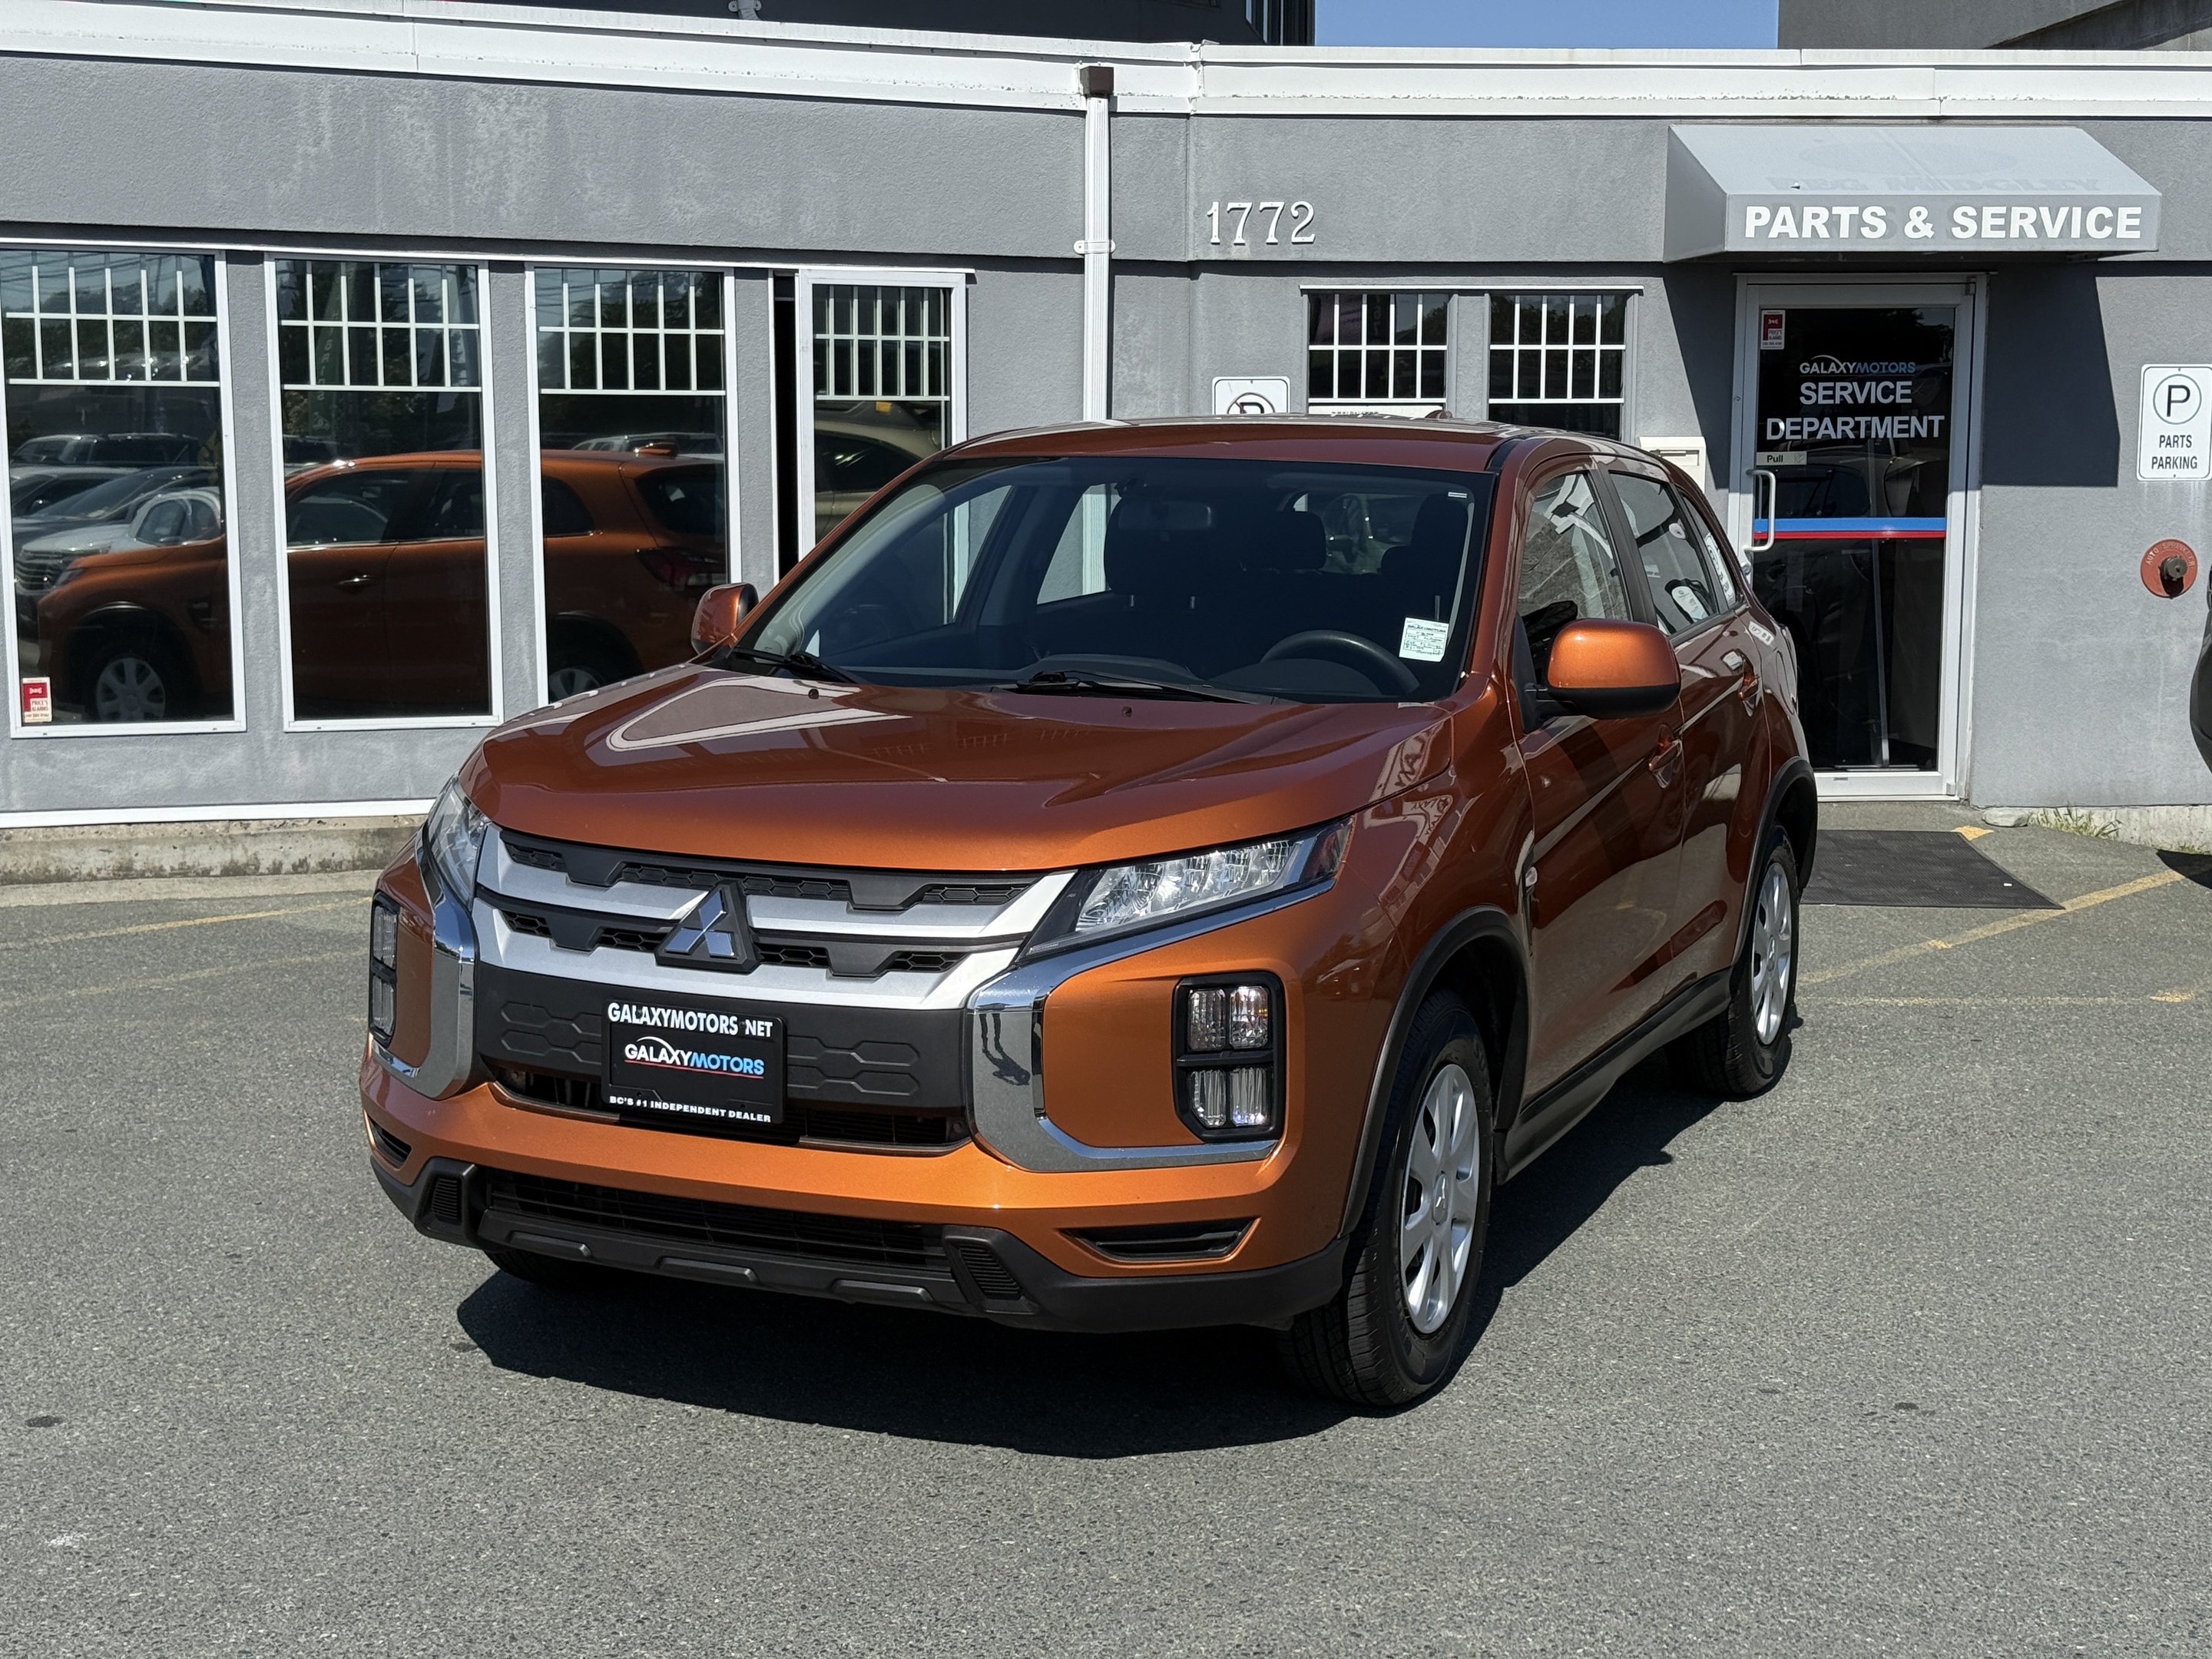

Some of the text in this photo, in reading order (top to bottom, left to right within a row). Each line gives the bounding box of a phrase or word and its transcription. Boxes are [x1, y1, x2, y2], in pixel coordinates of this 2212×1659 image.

[1207, 200, 1316, 244] 1772
[1744, 206, 2143, 240] PARTS & SERVICE
[1800, 361, 1916, 375] GALAXYMOTORS
[1800, 381, 1912, 405] SERVICE
[1767, 416, 1945, 440] DEPARTMENT
[2158, 434, 2192, 449] PARTS
[1767, 454, 1783, 463] Pull
[2151, 456, 2197, 470] PARKING
[2145, 547, 2160, 565] AUTO
[624, 1042, 765, 1075] GALAXYMOTORS
[609, 1096, 771, 1123] BC'S #1 INDEPENDENT DEALER
